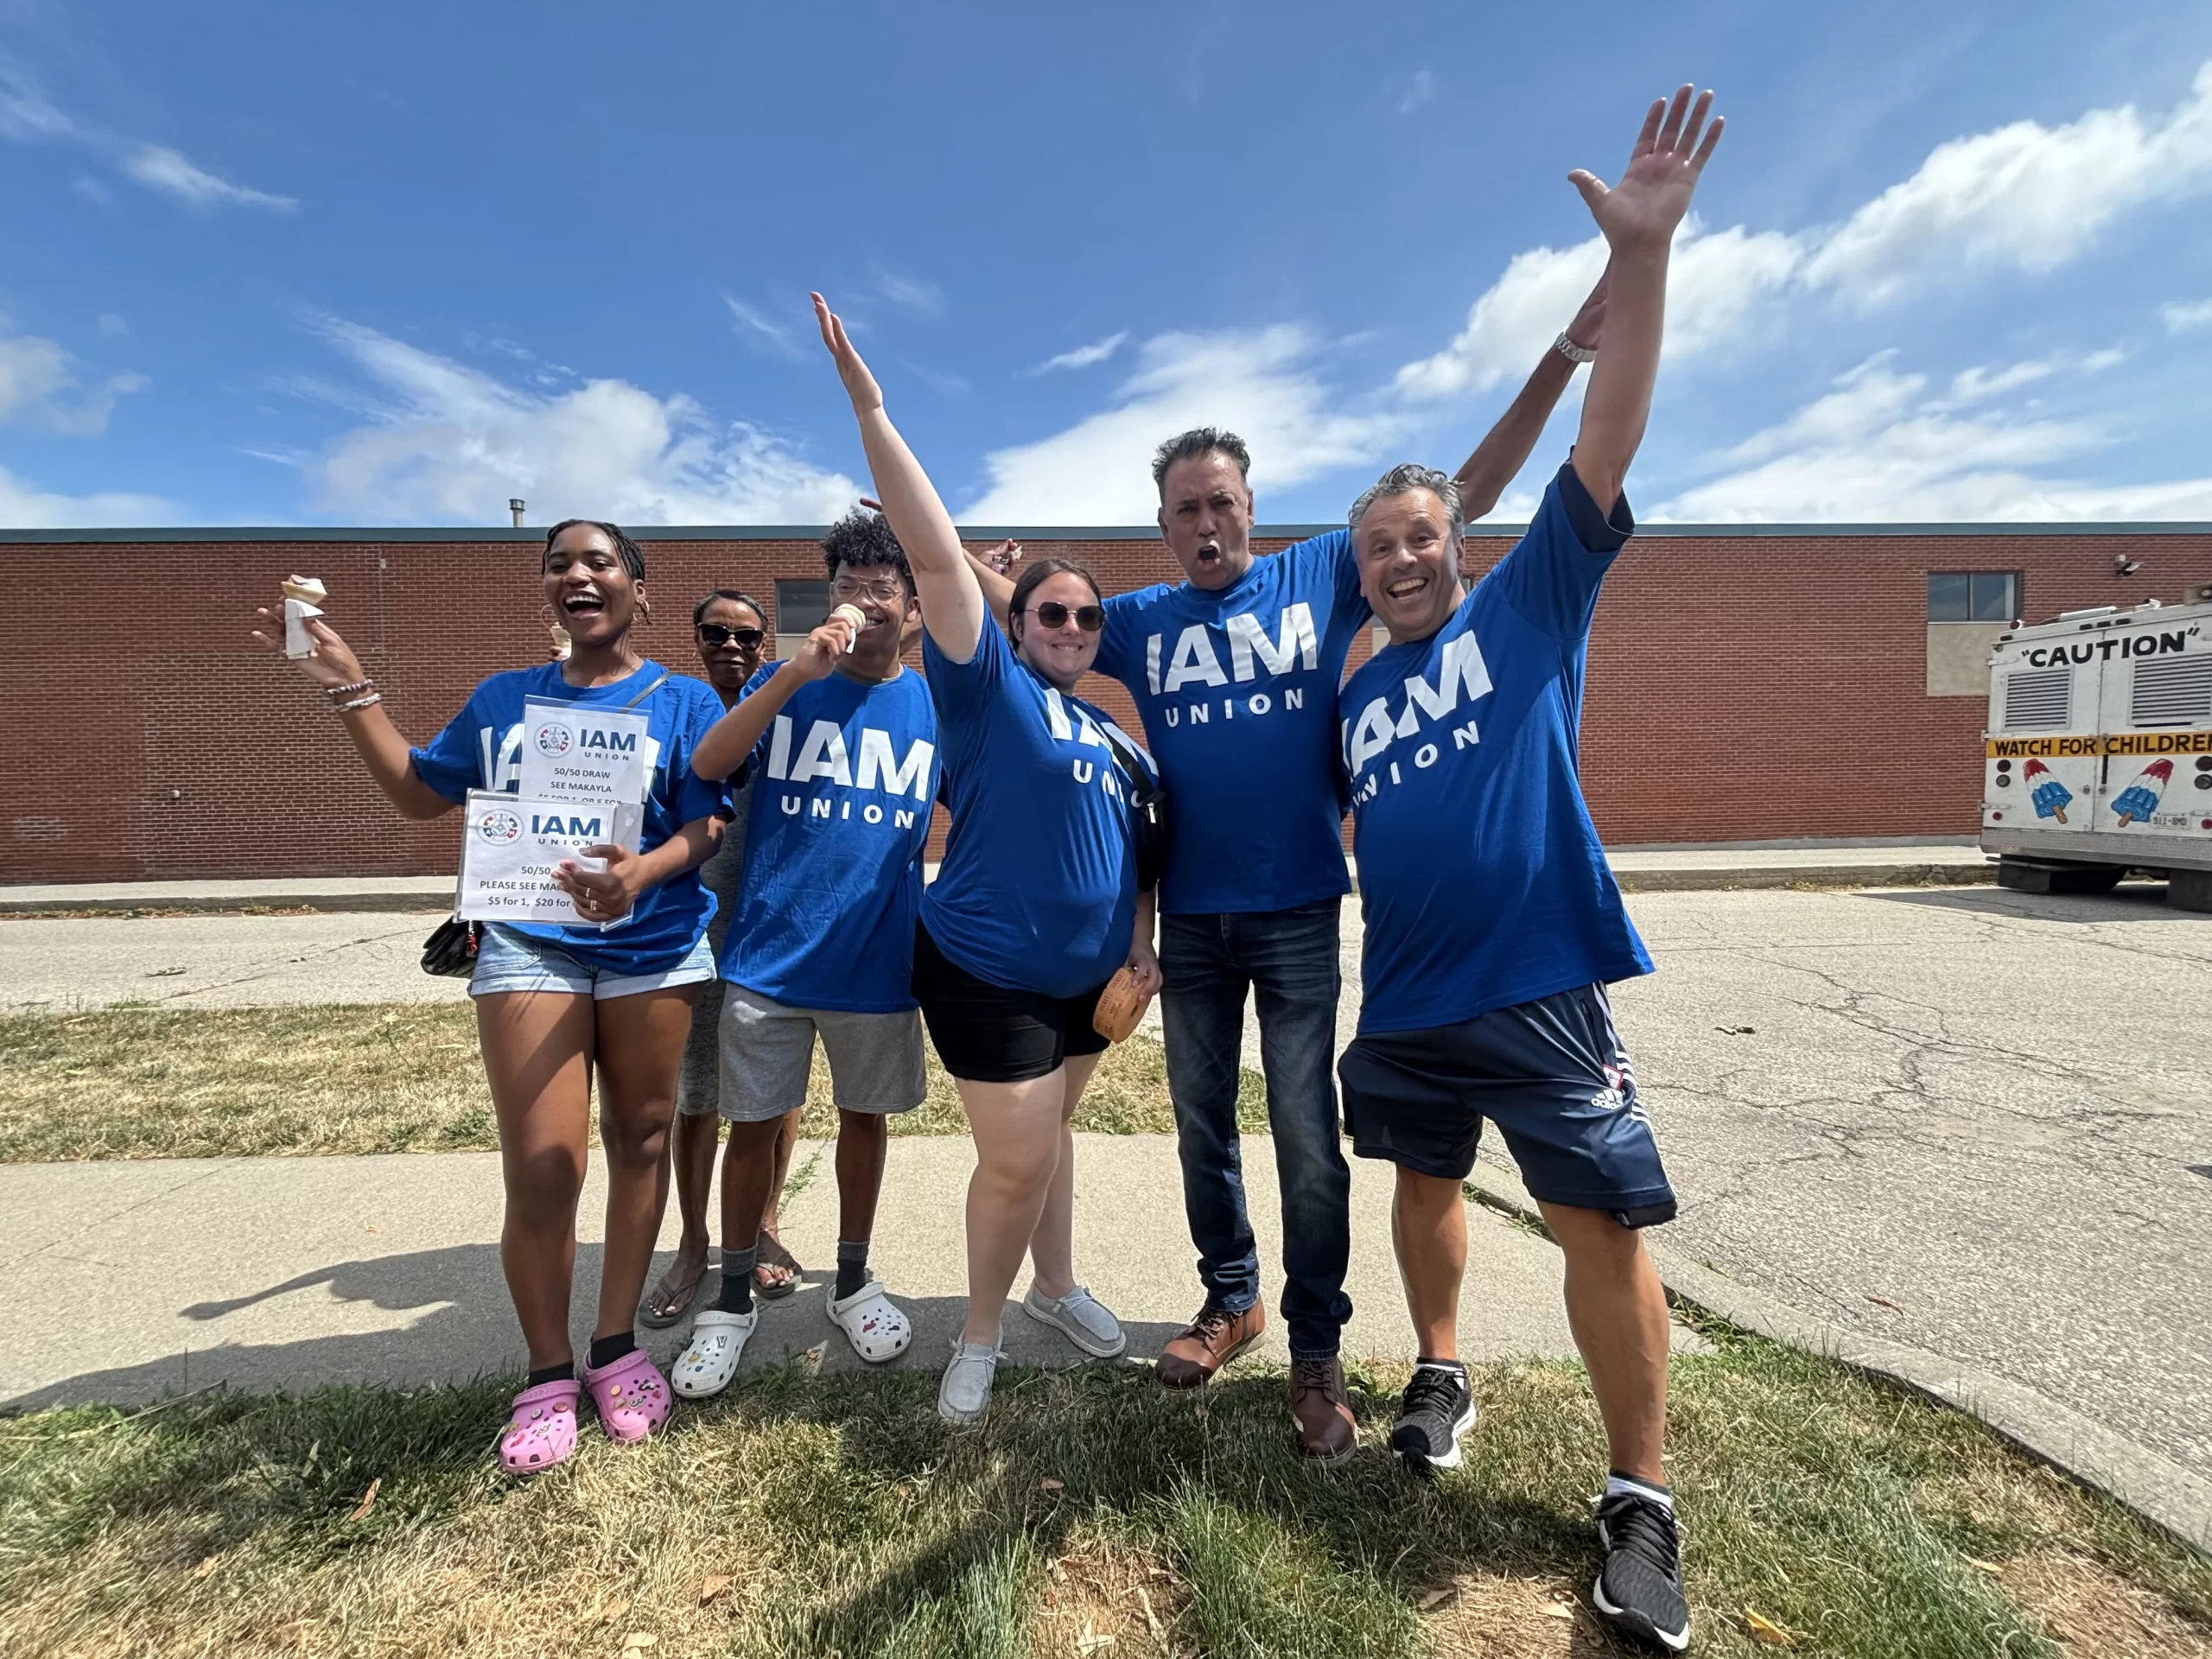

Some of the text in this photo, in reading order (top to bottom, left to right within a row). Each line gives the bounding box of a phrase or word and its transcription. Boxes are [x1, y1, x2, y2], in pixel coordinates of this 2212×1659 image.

[1147, 602, 1318, 696] IAM
[1165, 688, 1303, 728] UNION
[1341, 629, 1494, 784] IAM
[580, 728, 637, 753] IAM
[1995, 740, 2051, 757] WATCH
[2059, 738, 2097, 755] FOR
[584, 752, 629, 761] UNION
[767, 715, 935, 803] IAM
[554, 767, 611, 779] 50/50 DRAW
[550, 781, 612, 793] SEE MAKAYLA
[781, 795, 914, 830] UNION
[531, 815, 601, 837] IAM
[538, 838, 594, 847] UNION
[521, 866, 551, 876] 50/50
[480, 880, 560, 892] PLEASE SEE MA
[487, 896, 571, 907] $5 for 1, $20 for
